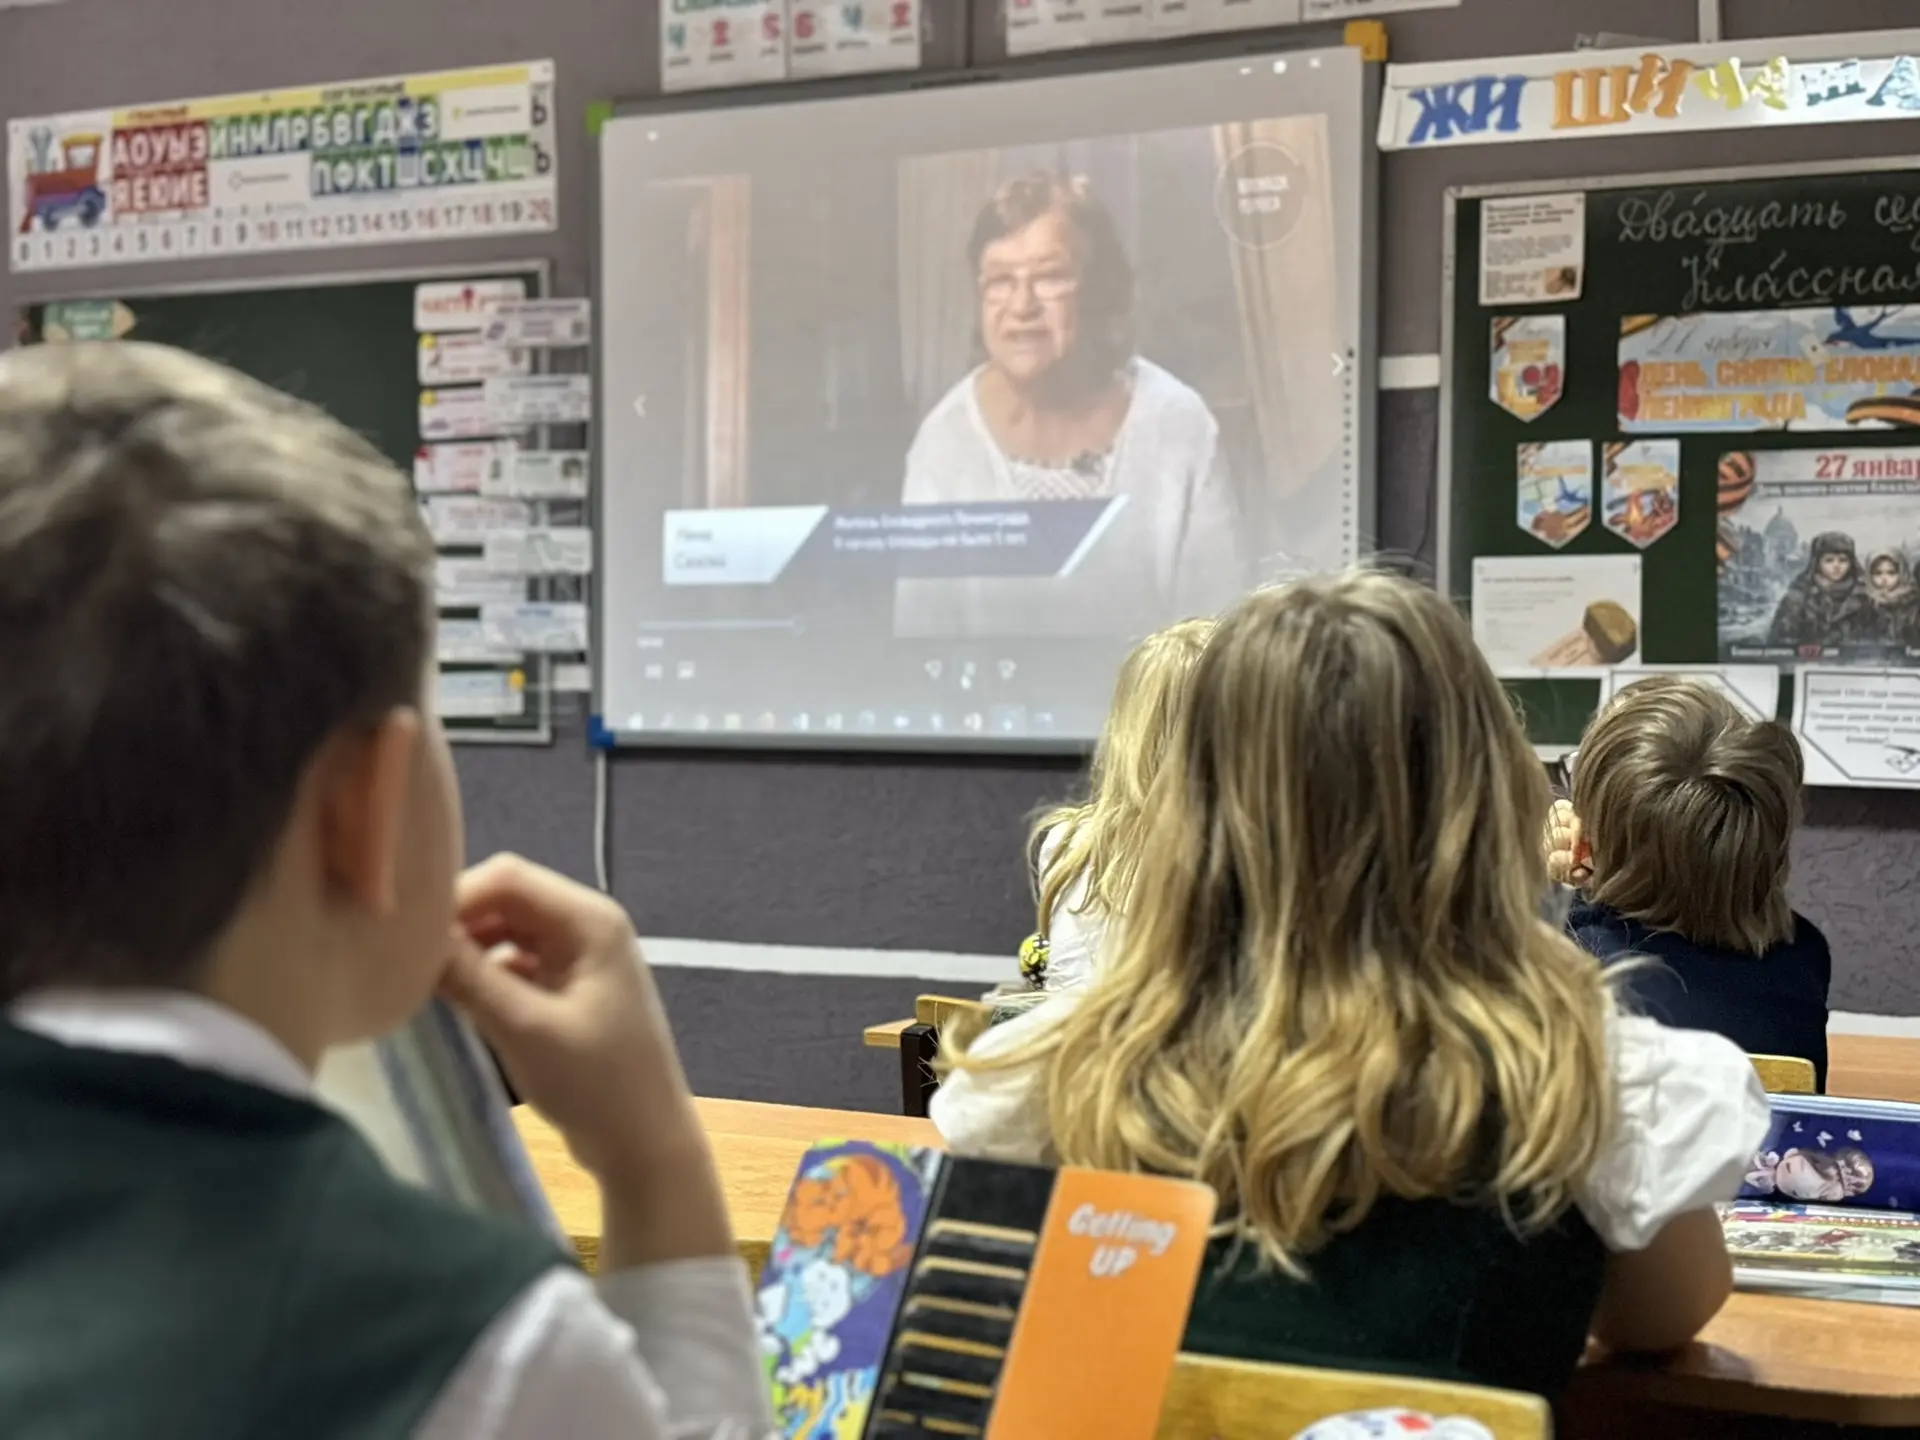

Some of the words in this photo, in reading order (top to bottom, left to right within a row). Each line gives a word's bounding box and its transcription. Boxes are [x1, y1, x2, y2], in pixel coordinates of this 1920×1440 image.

[1407, 75, 1528, 144] ЖИ
[1551, 54, 1695, 128] ШИ
[1815, 453, 1849, 480] 27
[1067, 1203, 1176, 1255] Getting
[1089, 1245, 1138, 1279] UP
